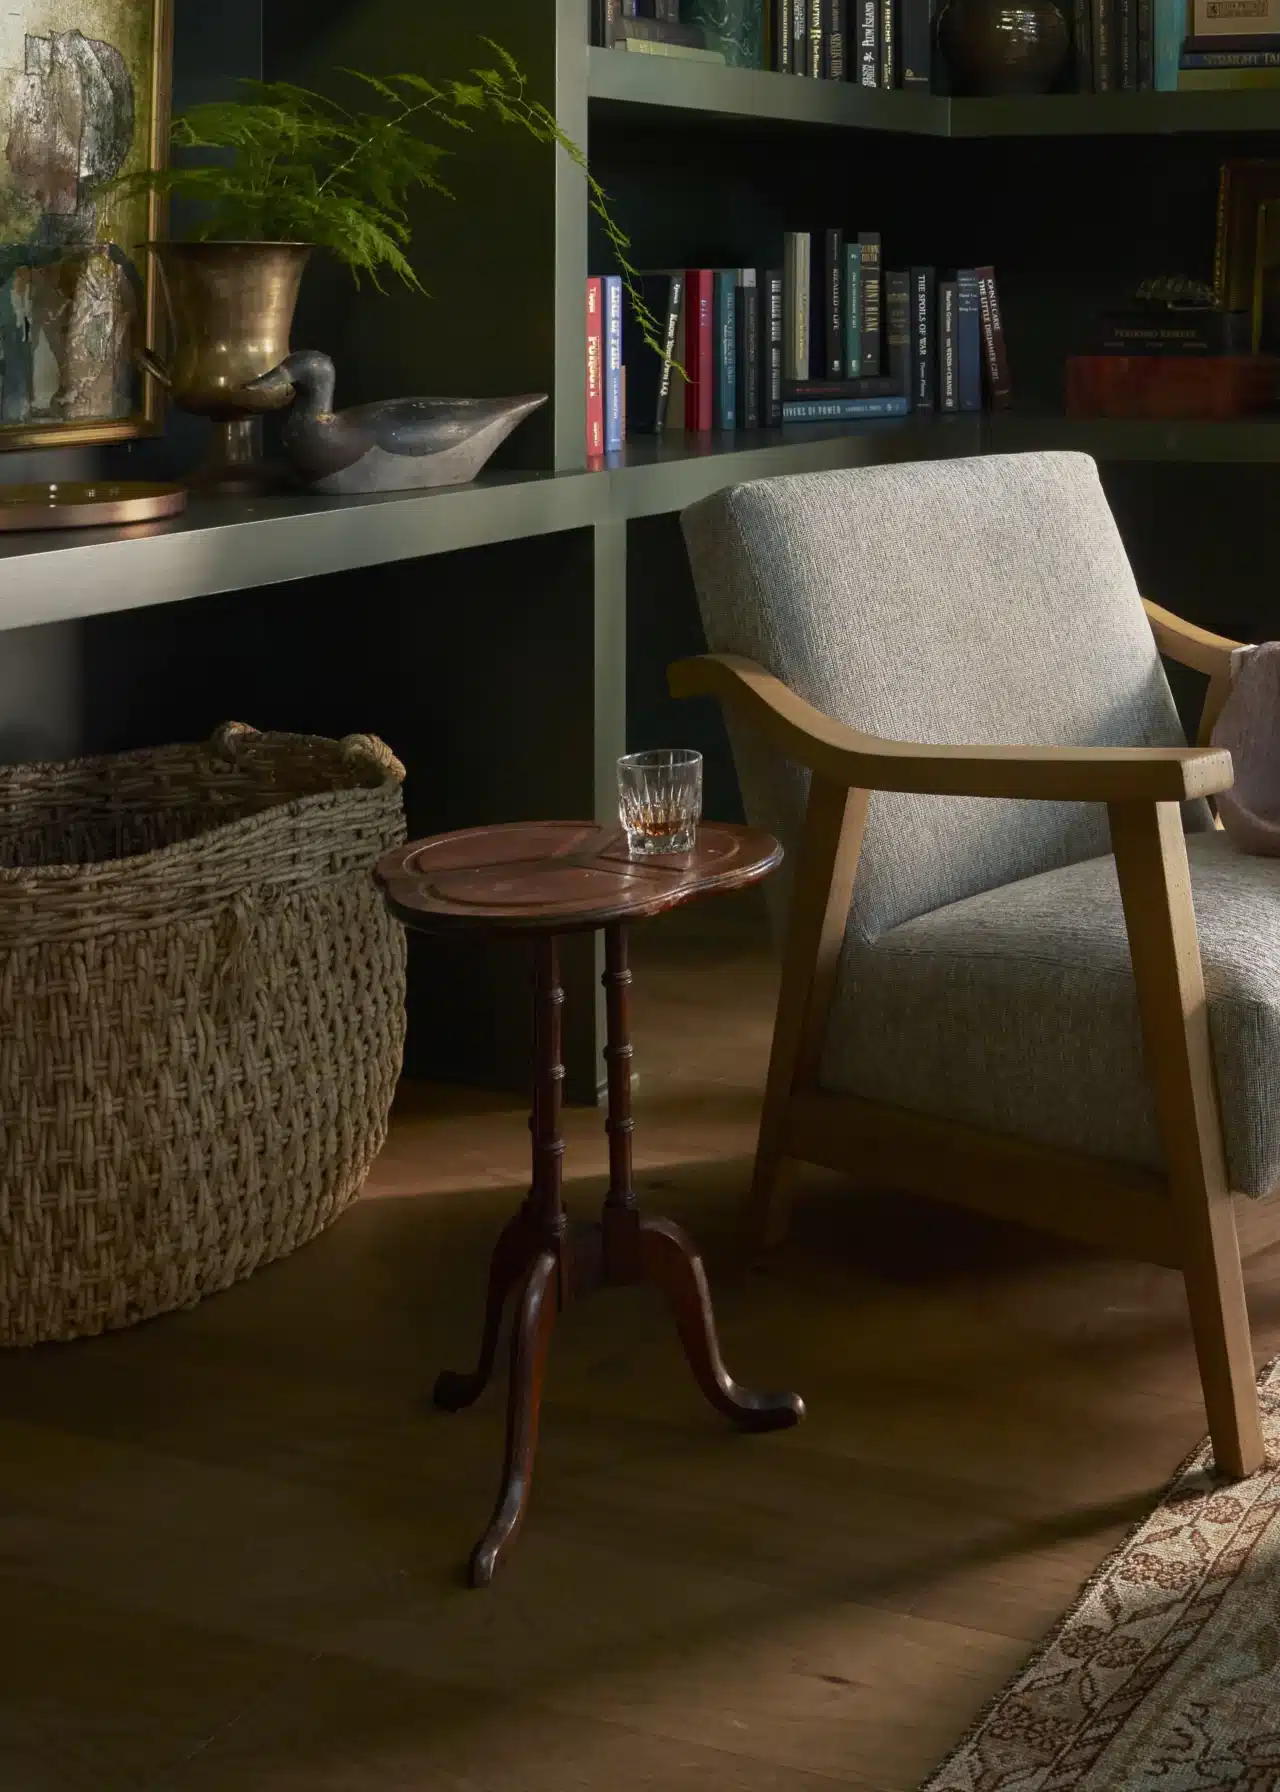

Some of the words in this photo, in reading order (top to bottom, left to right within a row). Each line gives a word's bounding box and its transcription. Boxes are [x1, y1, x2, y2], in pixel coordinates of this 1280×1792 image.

[861, 1, 875, 28] ISLAND
[809, 27, 822, 40] R
[861, 28, 875, 47] PLUM
[1203, 53, 1257, 65] STRAIGHT
[864, 280, 879, 302] POINT
[918, 274, 926, 292] THE
[978, 279, 986, 296] THE
[986, 278, 996, 298] JOHN
[611, 286, 620, 318] LINE
[771, 295, 782, 319] BLACK
[918, 293, 926, 322] SPOILS
[980, 296, 990, 322] LITTLE
[989, 299, 997, 308] LE
[611, 320, 620, 334] OF
[667, 313, 678, 338] Know
[864, 306, 879, 333] BLANK
[918, 323, 926, 335] OF
[771, 321, 782, 342] BOOK
[666, 339, 676, 359] Your
[918, 337, 927, 356] WAR
[984, 324, 996, 363] DRUMMER
[663, 359, 672, 380] Own
[990, 363, 1000, 382] GIRL
[808, 406, 816, 416] OF
[818, 405, 841, 415] POWER
